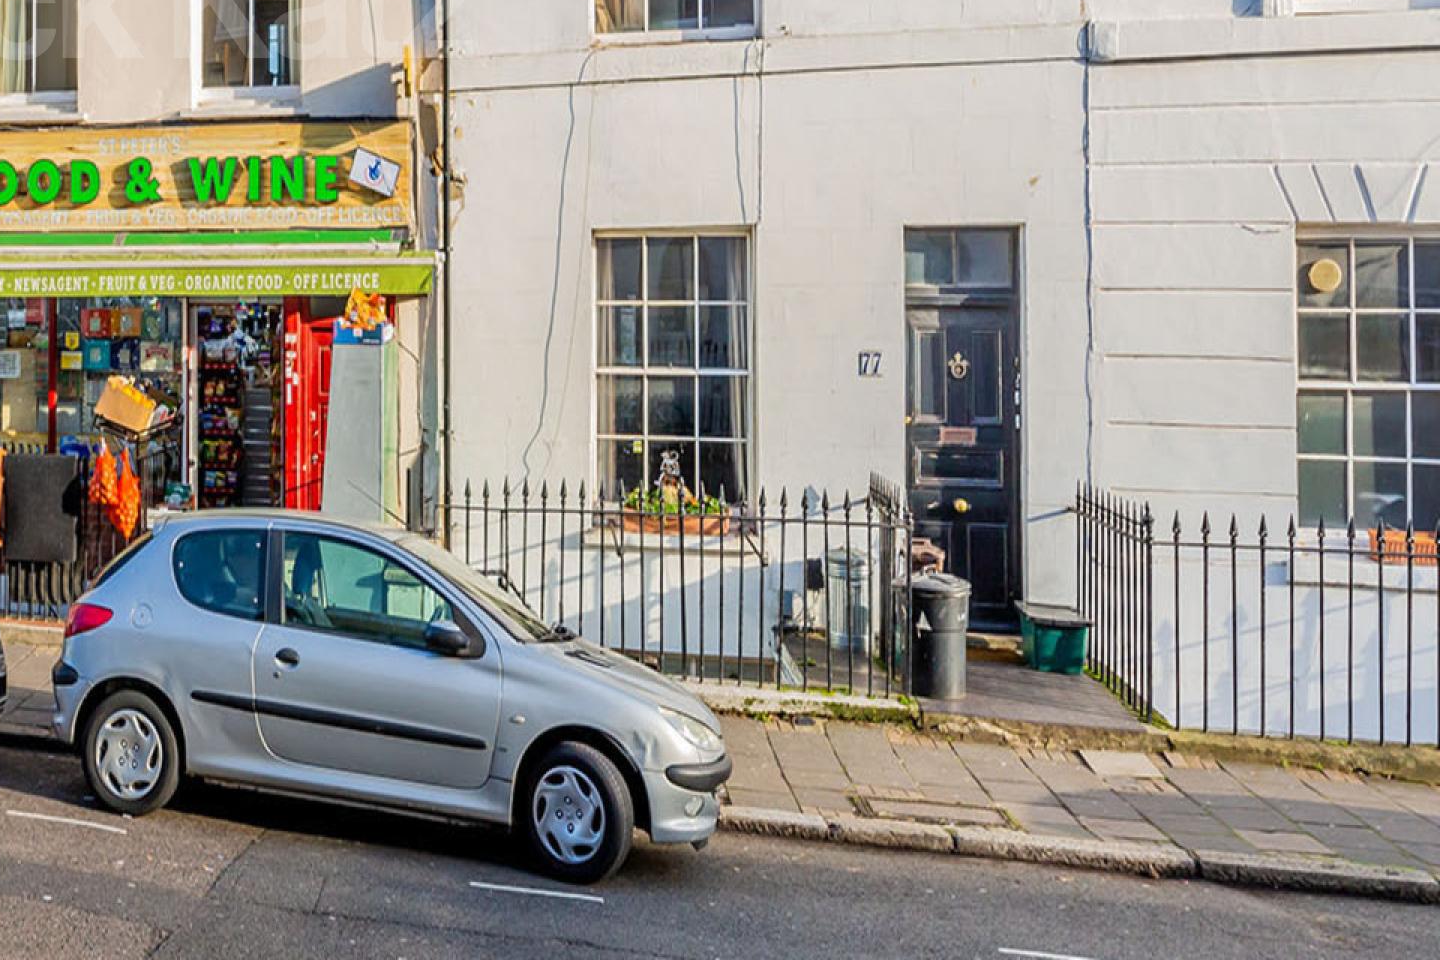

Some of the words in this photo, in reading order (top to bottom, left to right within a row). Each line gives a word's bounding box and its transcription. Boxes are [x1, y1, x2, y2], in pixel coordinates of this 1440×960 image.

[98, 137, 115, 155] ST
[124, 156, 161, 203] &
[188, 154, 339, 203] WINE
[85, 209, 130, 225] FRUIT
[146, 208, 176, 224] VEG
[187, 207, 250, 225] ORGANIC
[254, 207, 297, 224] FOOD
[308, 207, 334, 223] OFF
[338, 206, 402, 223] LICENCE
[13, 276, 89, 292] NEWSAGENT
[98, 275, 136, 291] FRUIT
[137, 275, 146, 291] &
[150, 275, 175, 291] VEG
[185, 274, 246, 290] ORGANIC
[248, 274, 283, 290] FOOD
[293, 273, 320, 289] OFF
[321, 272, 380, 289] LICENCE
[858, 351, 883, 377] 177
